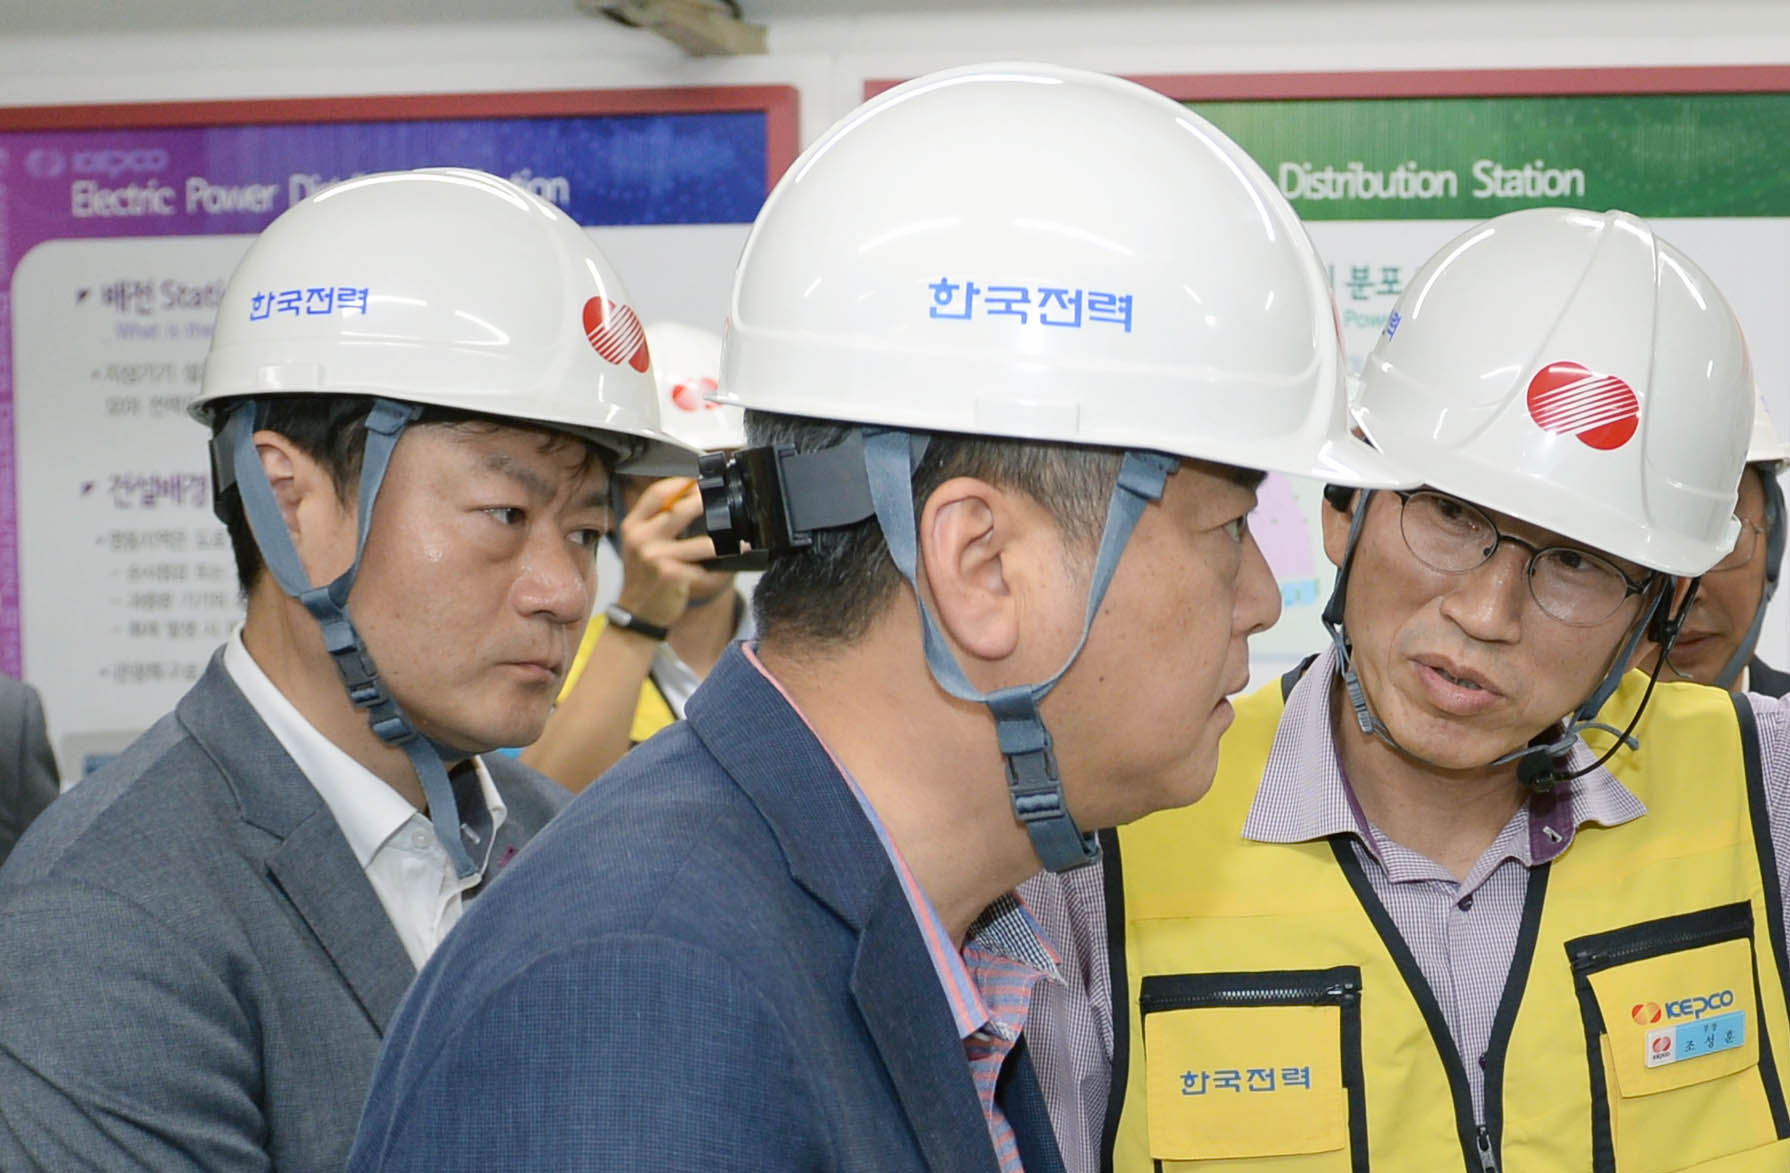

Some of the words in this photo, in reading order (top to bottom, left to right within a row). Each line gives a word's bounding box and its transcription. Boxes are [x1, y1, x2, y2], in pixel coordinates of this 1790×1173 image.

[71, 178, 177, 217] Electric
[185, 176, 280, 214] Power
[1278, 161, 1458, 199] Distribution
[1472, 158, 1586, 198] Station
[1345, 264, 1402, 301] 분포
[249, 286, 369, 321] 한국전력
[928, 276, 1133, 333] 한국전력
[1179, 1066, 1310, 1096] 한국전력
